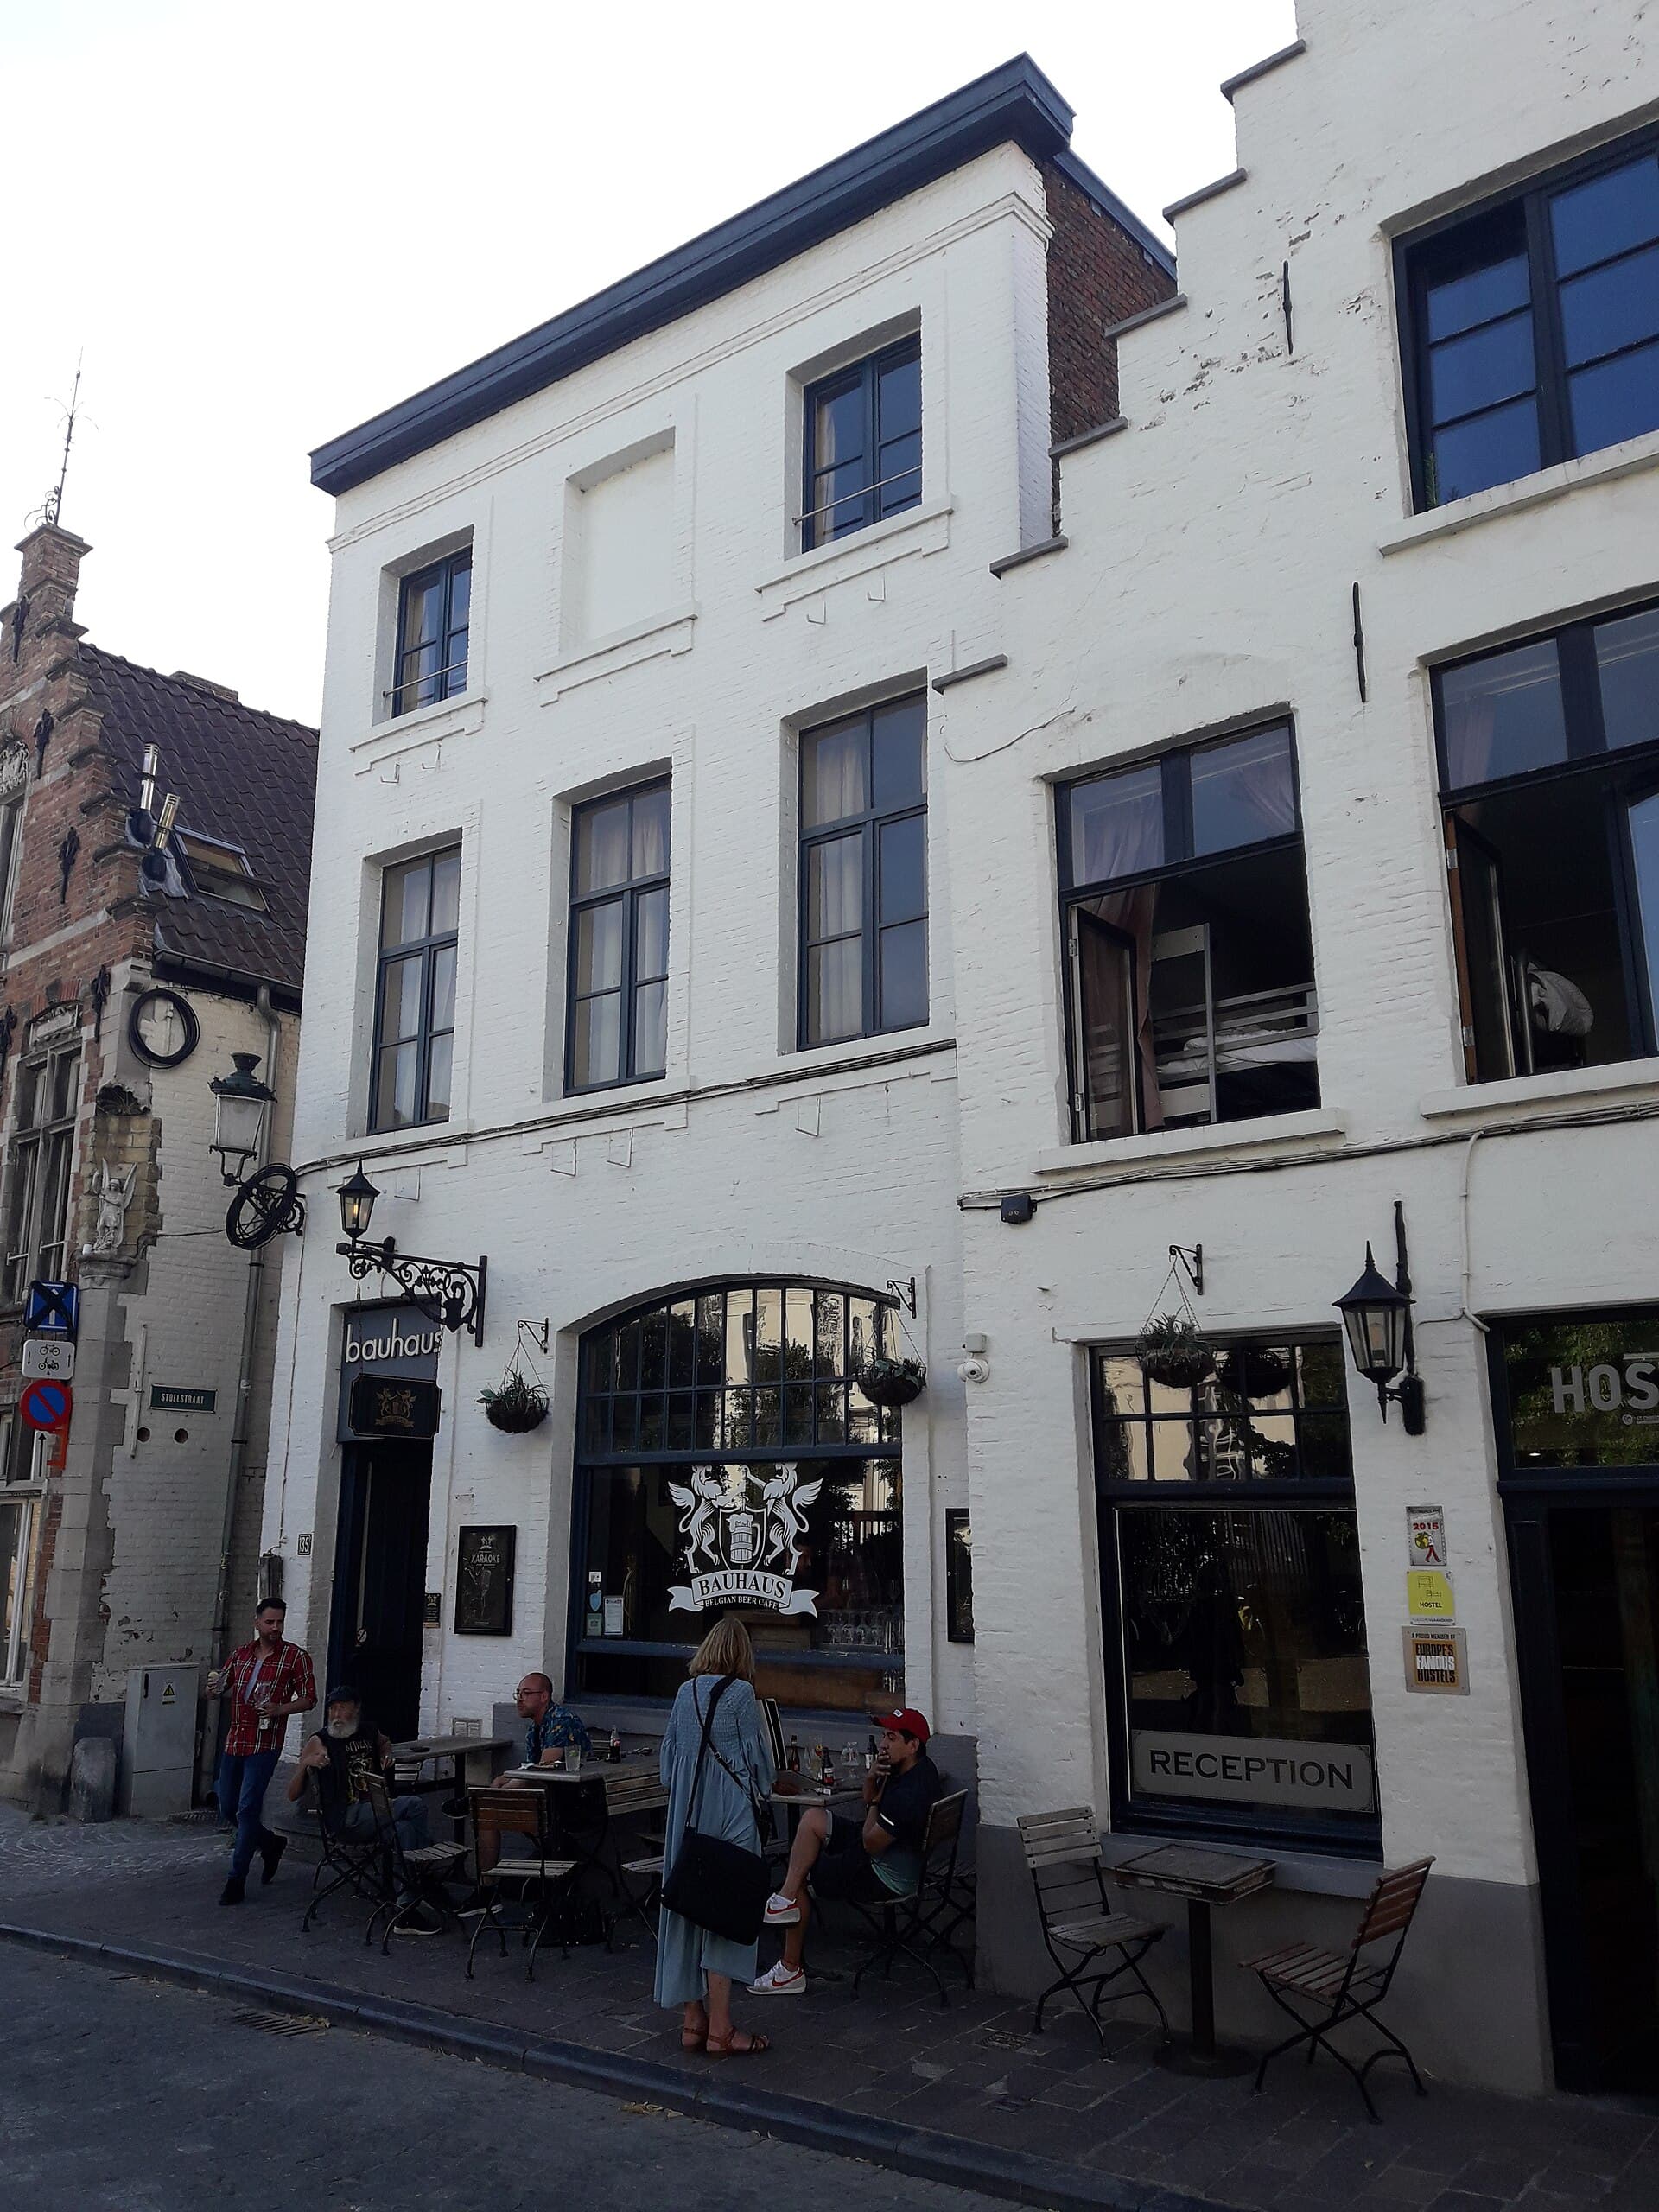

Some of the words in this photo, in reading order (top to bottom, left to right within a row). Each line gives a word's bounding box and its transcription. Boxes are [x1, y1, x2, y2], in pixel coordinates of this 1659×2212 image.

[345, 1317, 442, 1363] bauhaus
[1551, 1362, 1659, 1413] HOS
[161, 1393, 204, 1404] STOELSTRAAT
[1412, 1522, 1439, 1531] 2015
[471, 1553, 501, 1564] KARAOKE
[698, 1573, 785, 1599] BAUHAUS
[705, 1596, 736, 1608] BELGIAN
[738, 1595, 757, 1605] BEER
[1415, 1643, 1453, 1656] EUROPE'S
[1416, 1656, 1455, 1670] FAMOUS
[1417, 1669, 1456, 1684] HOSTELS
[1149, 1749, 1354, 1789] RECEPTION
